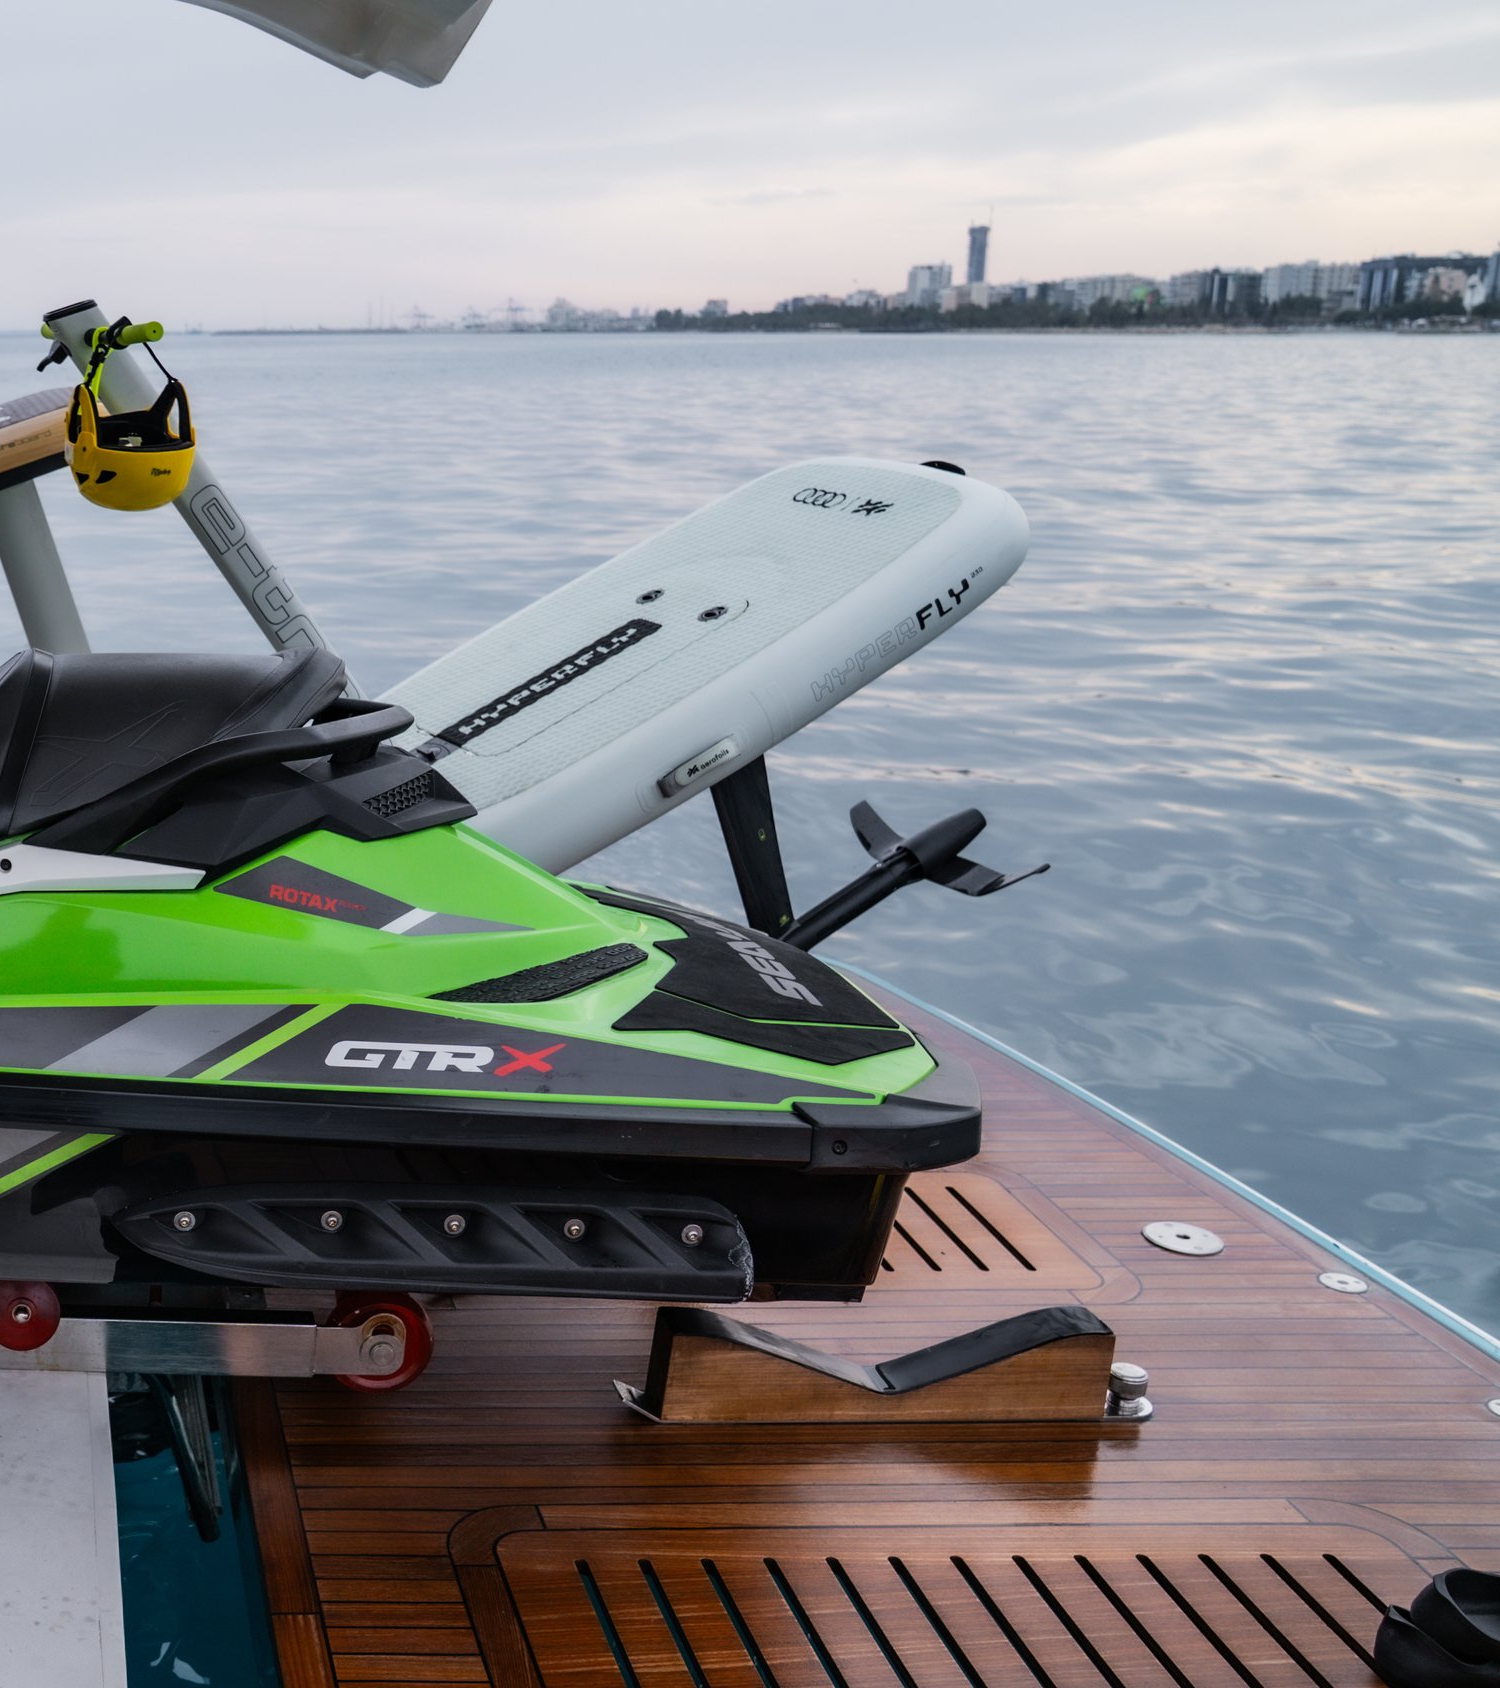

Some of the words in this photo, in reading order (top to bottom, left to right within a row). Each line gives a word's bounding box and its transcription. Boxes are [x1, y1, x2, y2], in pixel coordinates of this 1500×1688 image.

[458, 628, 637, 735] HYPERFLY
[700, 749, 729, 770] aerofoils
[269, 884, 338, 912] ROTAX
